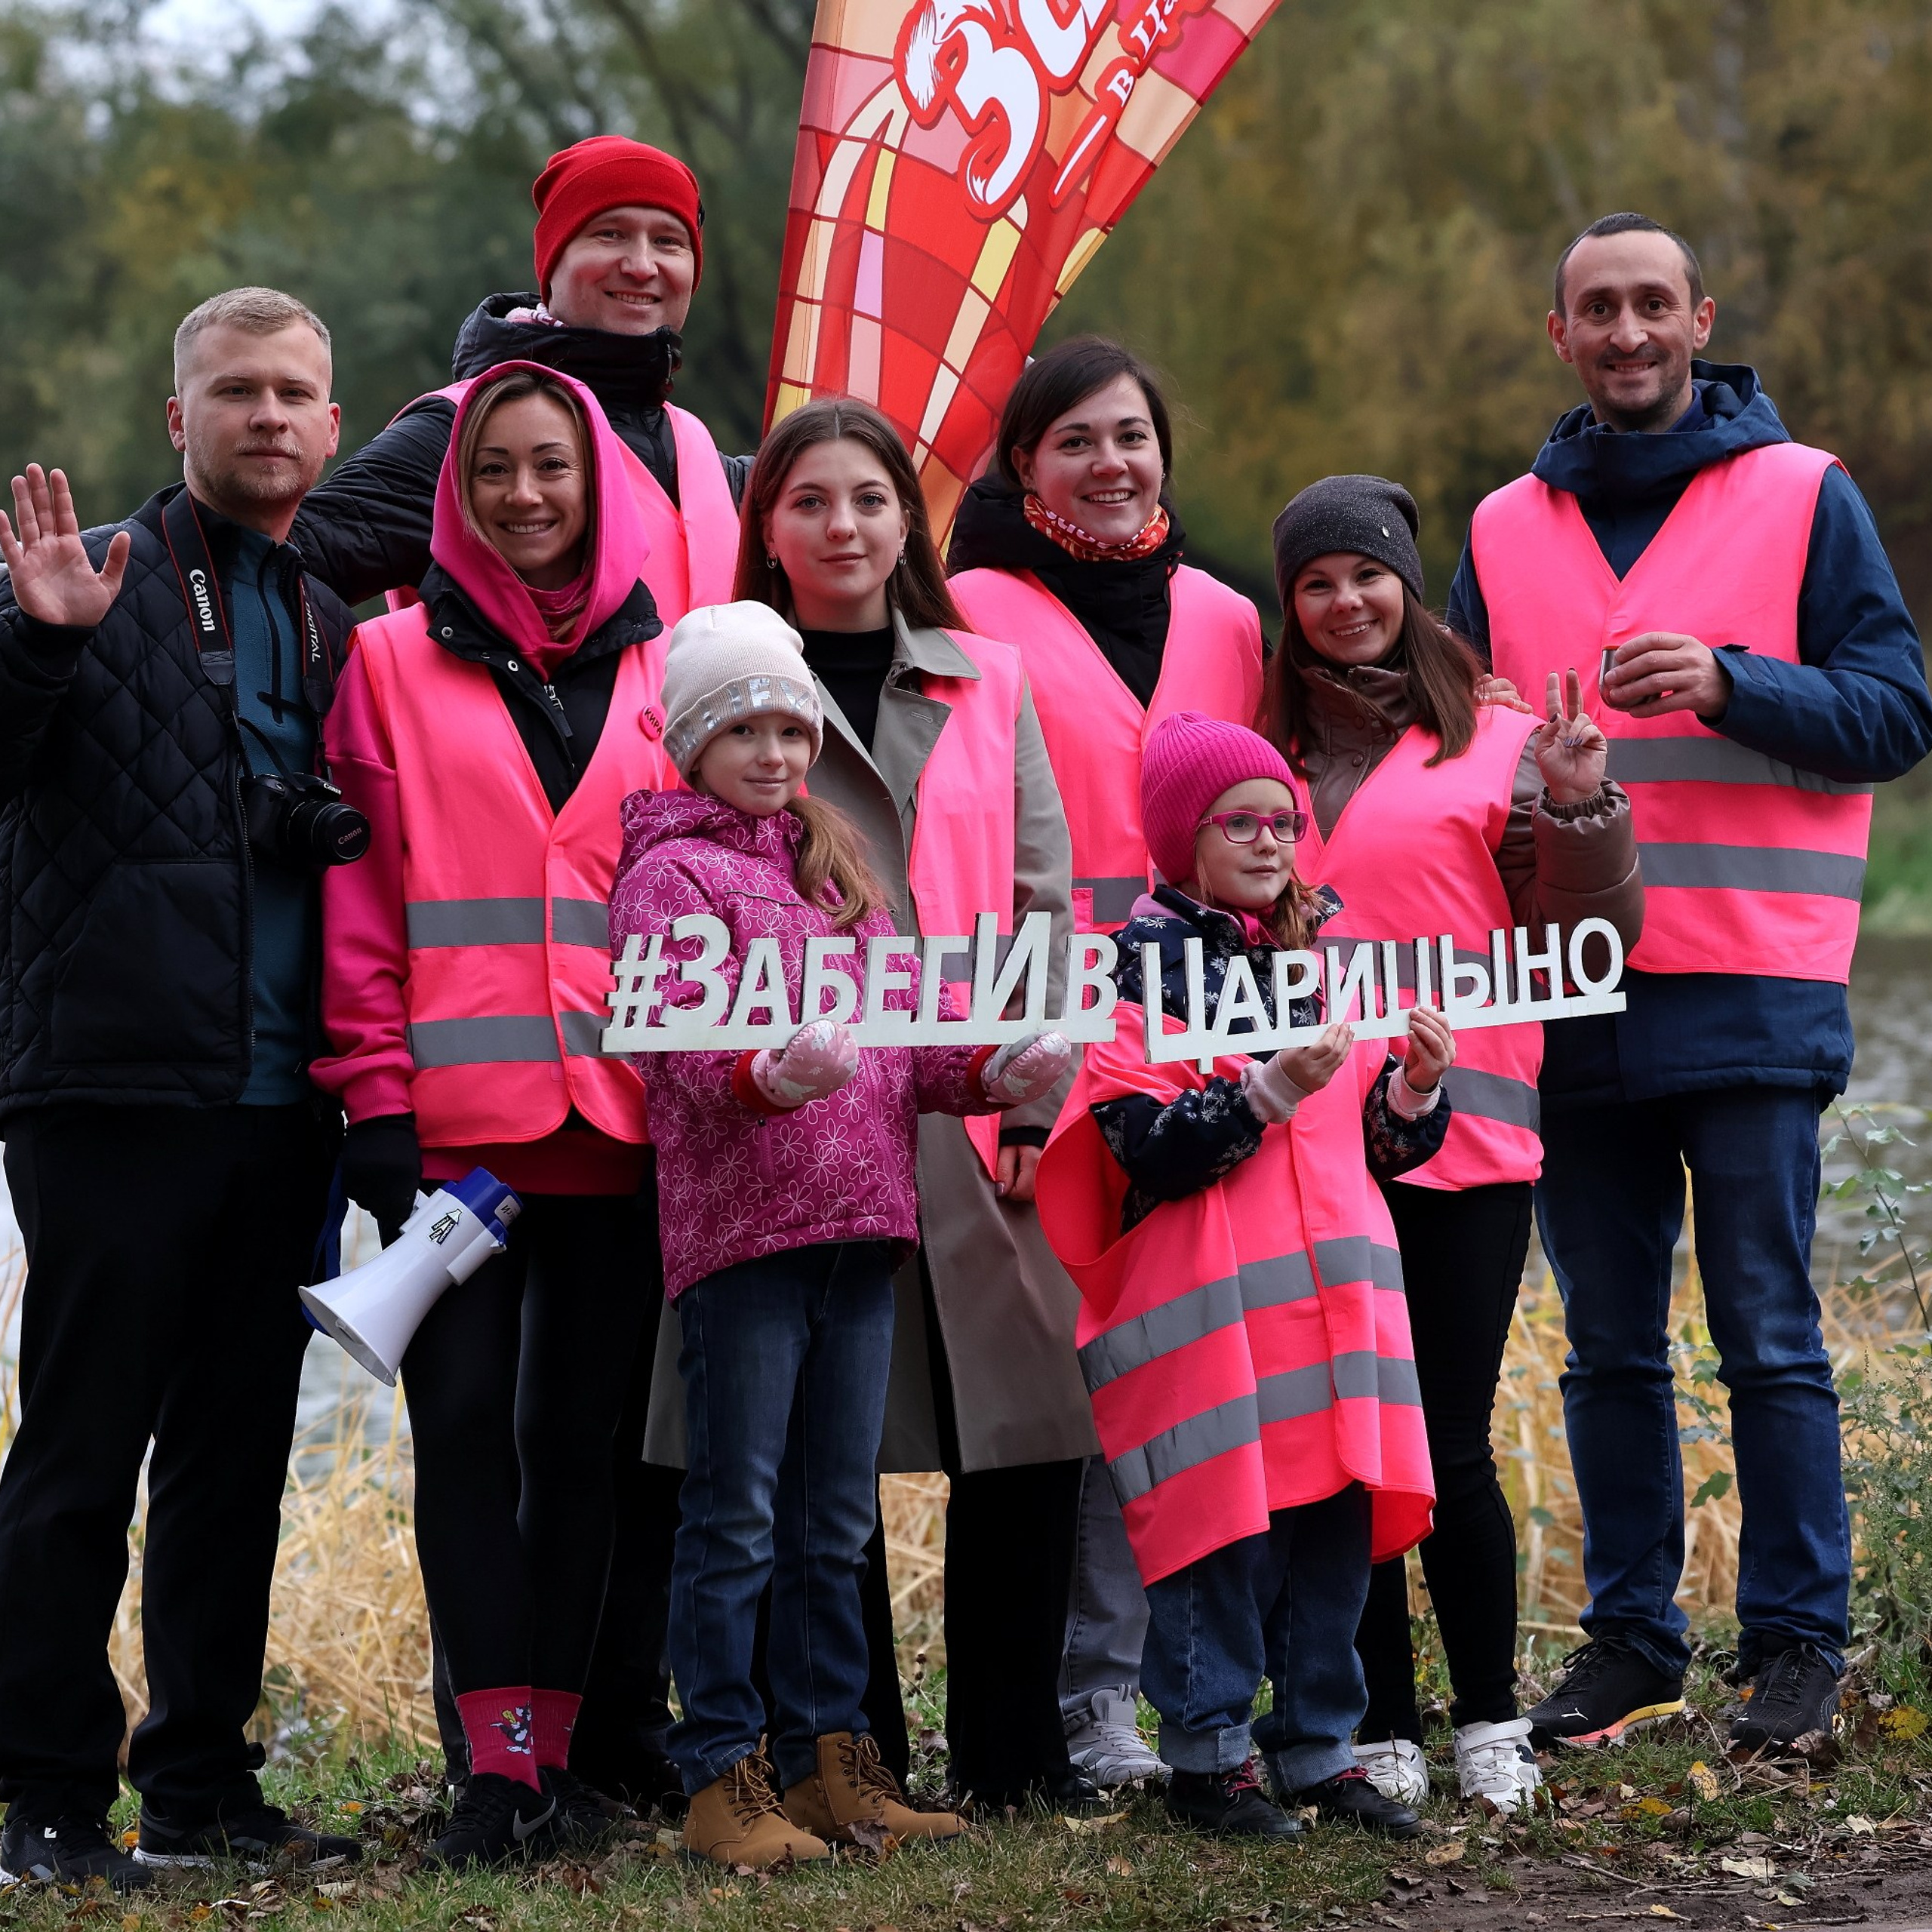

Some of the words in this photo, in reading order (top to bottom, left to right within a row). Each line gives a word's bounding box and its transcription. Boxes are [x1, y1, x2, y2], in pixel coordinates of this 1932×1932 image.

[189, 568, 216, 632] Canon
[305, 601, 321, 663] DIGITAL
[644, 707, 663, 738] КИРА
[323, 783, 342, 795] Canon
[337, 826, 362, 844] Canon
[1141, 916, 1626, 1075] ЦАРИЦЫНО
